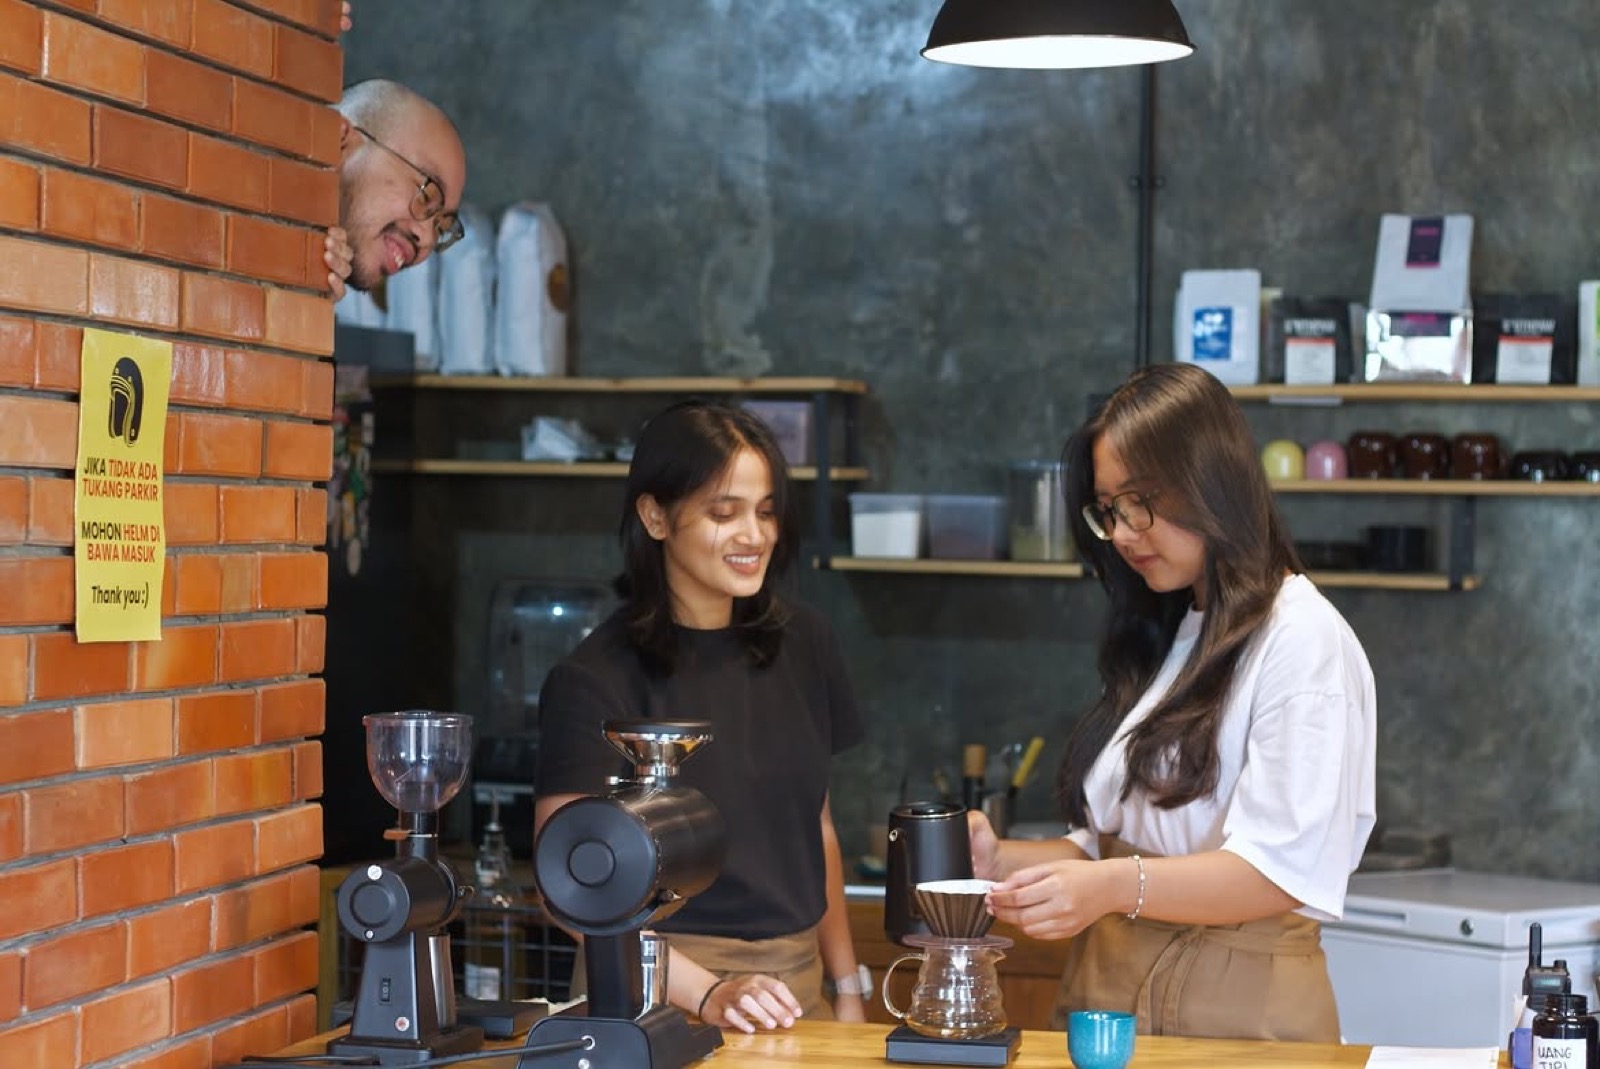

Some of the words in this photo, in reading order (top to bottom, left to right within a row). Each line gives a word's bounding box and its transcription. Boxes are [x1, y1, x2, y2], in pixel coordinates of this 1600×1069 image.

[84, 457, 106, 476] JIKA
[109, 460, 136, 479] TIDAK
[138, 463, 158, 481] ADA
[83, 478, 123, 498] TUKANG
[125, 482, 158, 501] PARKIR
[82, 521, 121, 541] MOHON
[123, 525, 149, 542] HELM
[87, 544, 119, 561] BAWA
[121, 546, 155, 563] MASUK
[91, 586, 121, 605] Thank
[1538, 1046, 1572, 1059] UANG
